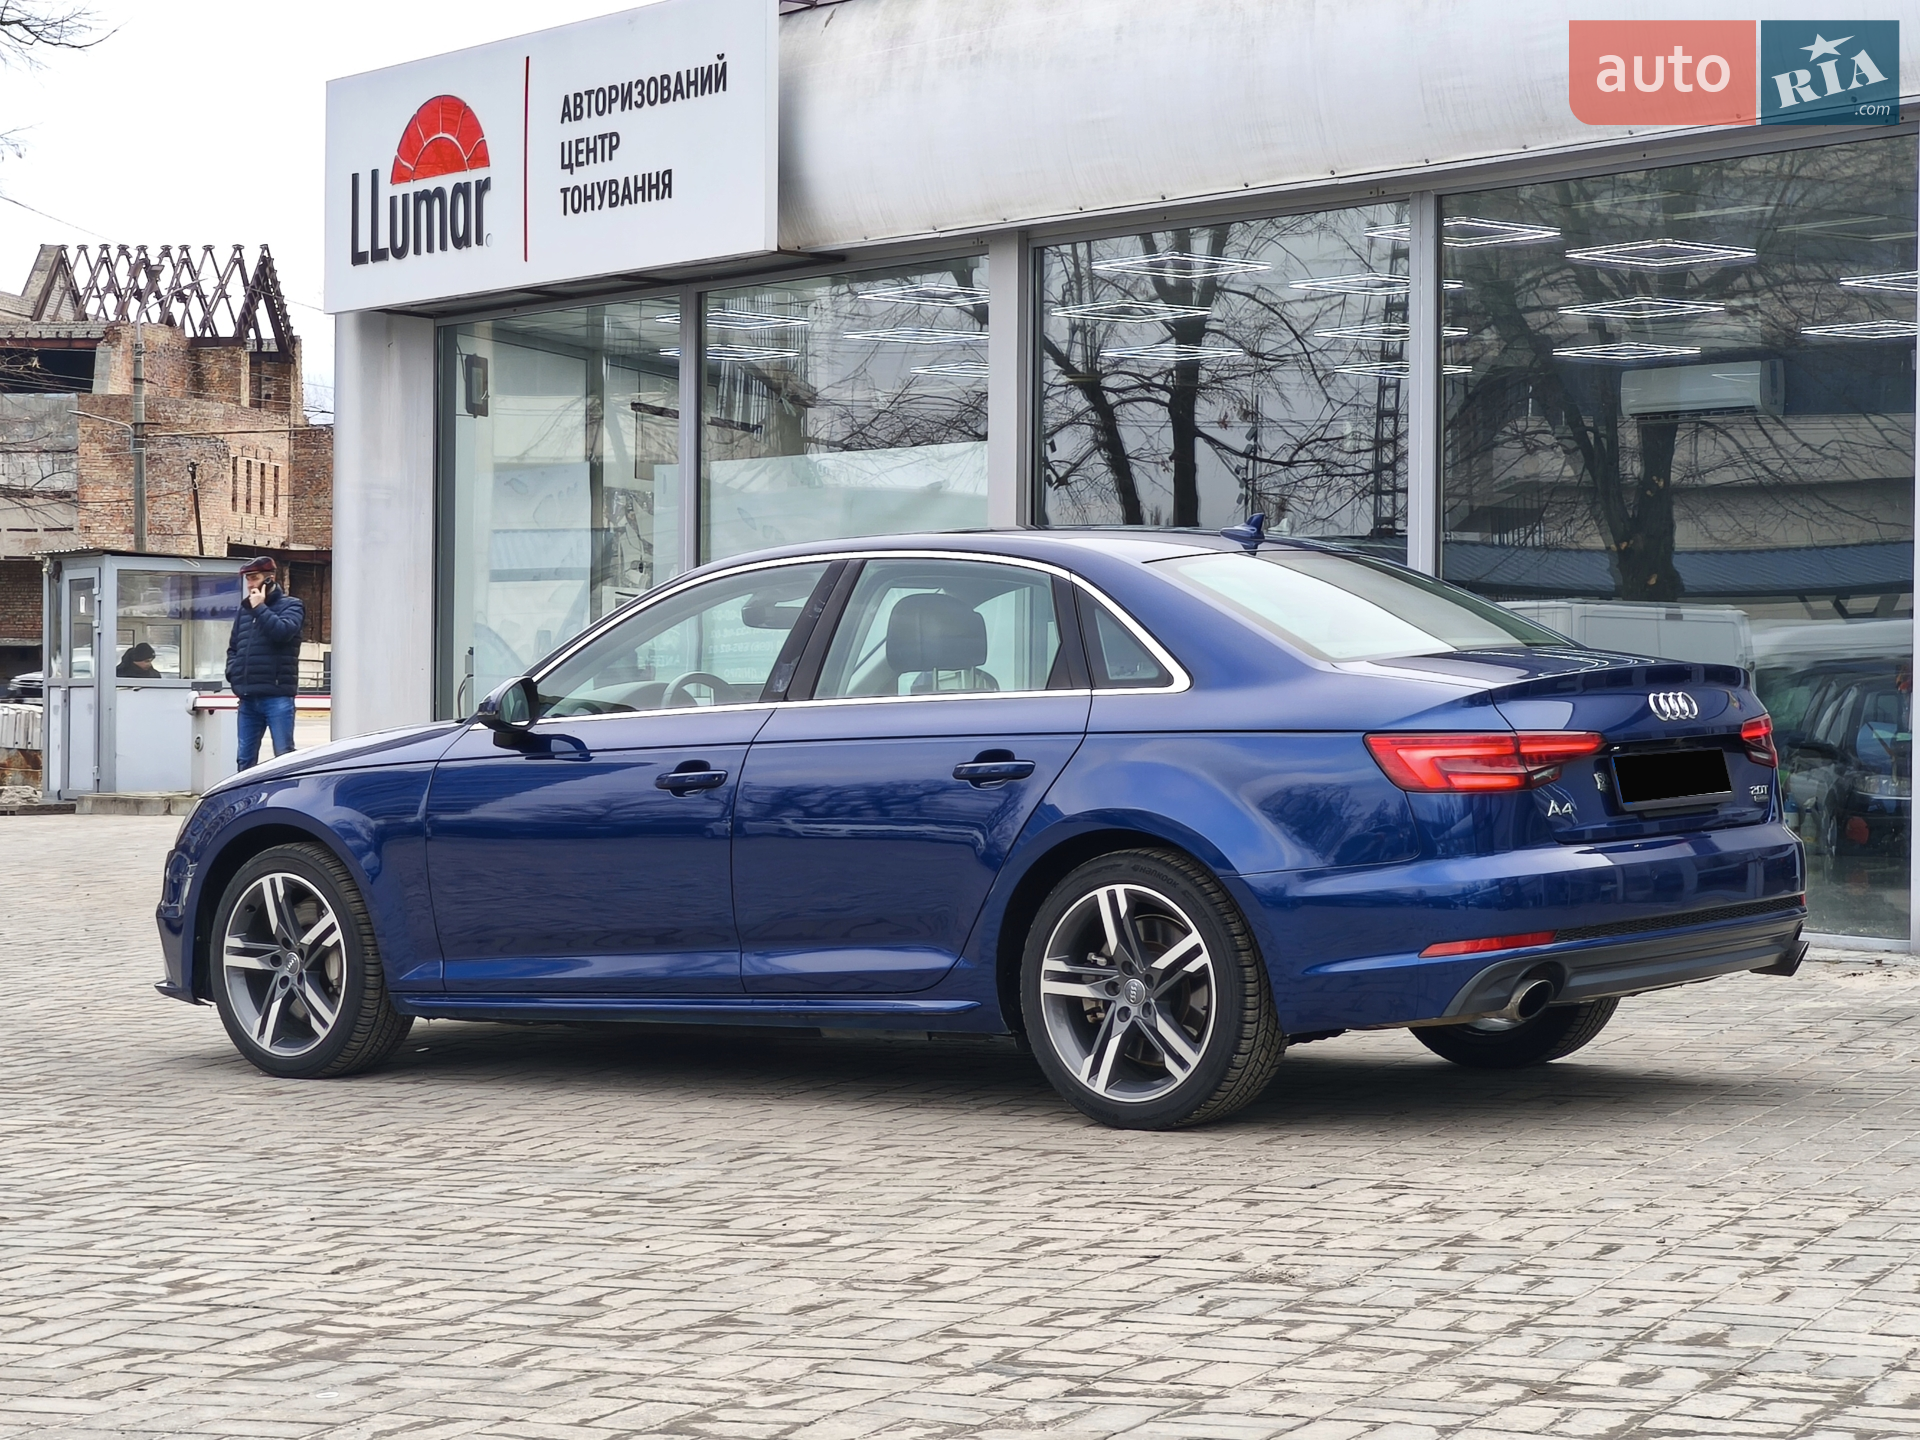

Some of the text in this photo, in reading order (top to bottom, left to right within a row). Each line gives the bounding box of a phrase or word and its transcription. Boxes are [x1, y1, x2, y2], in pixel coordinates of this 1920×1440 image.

[560, 53, 728, 125] АВТОРИЗОВАНИЙ
[560, 131, 621, 176] ЦЕНТР
[560, 168, 673, 217] ТОНУВАННЯ
[351, 168, 491, 267] LLumar
[1547, 799, 1573, 817] A4
